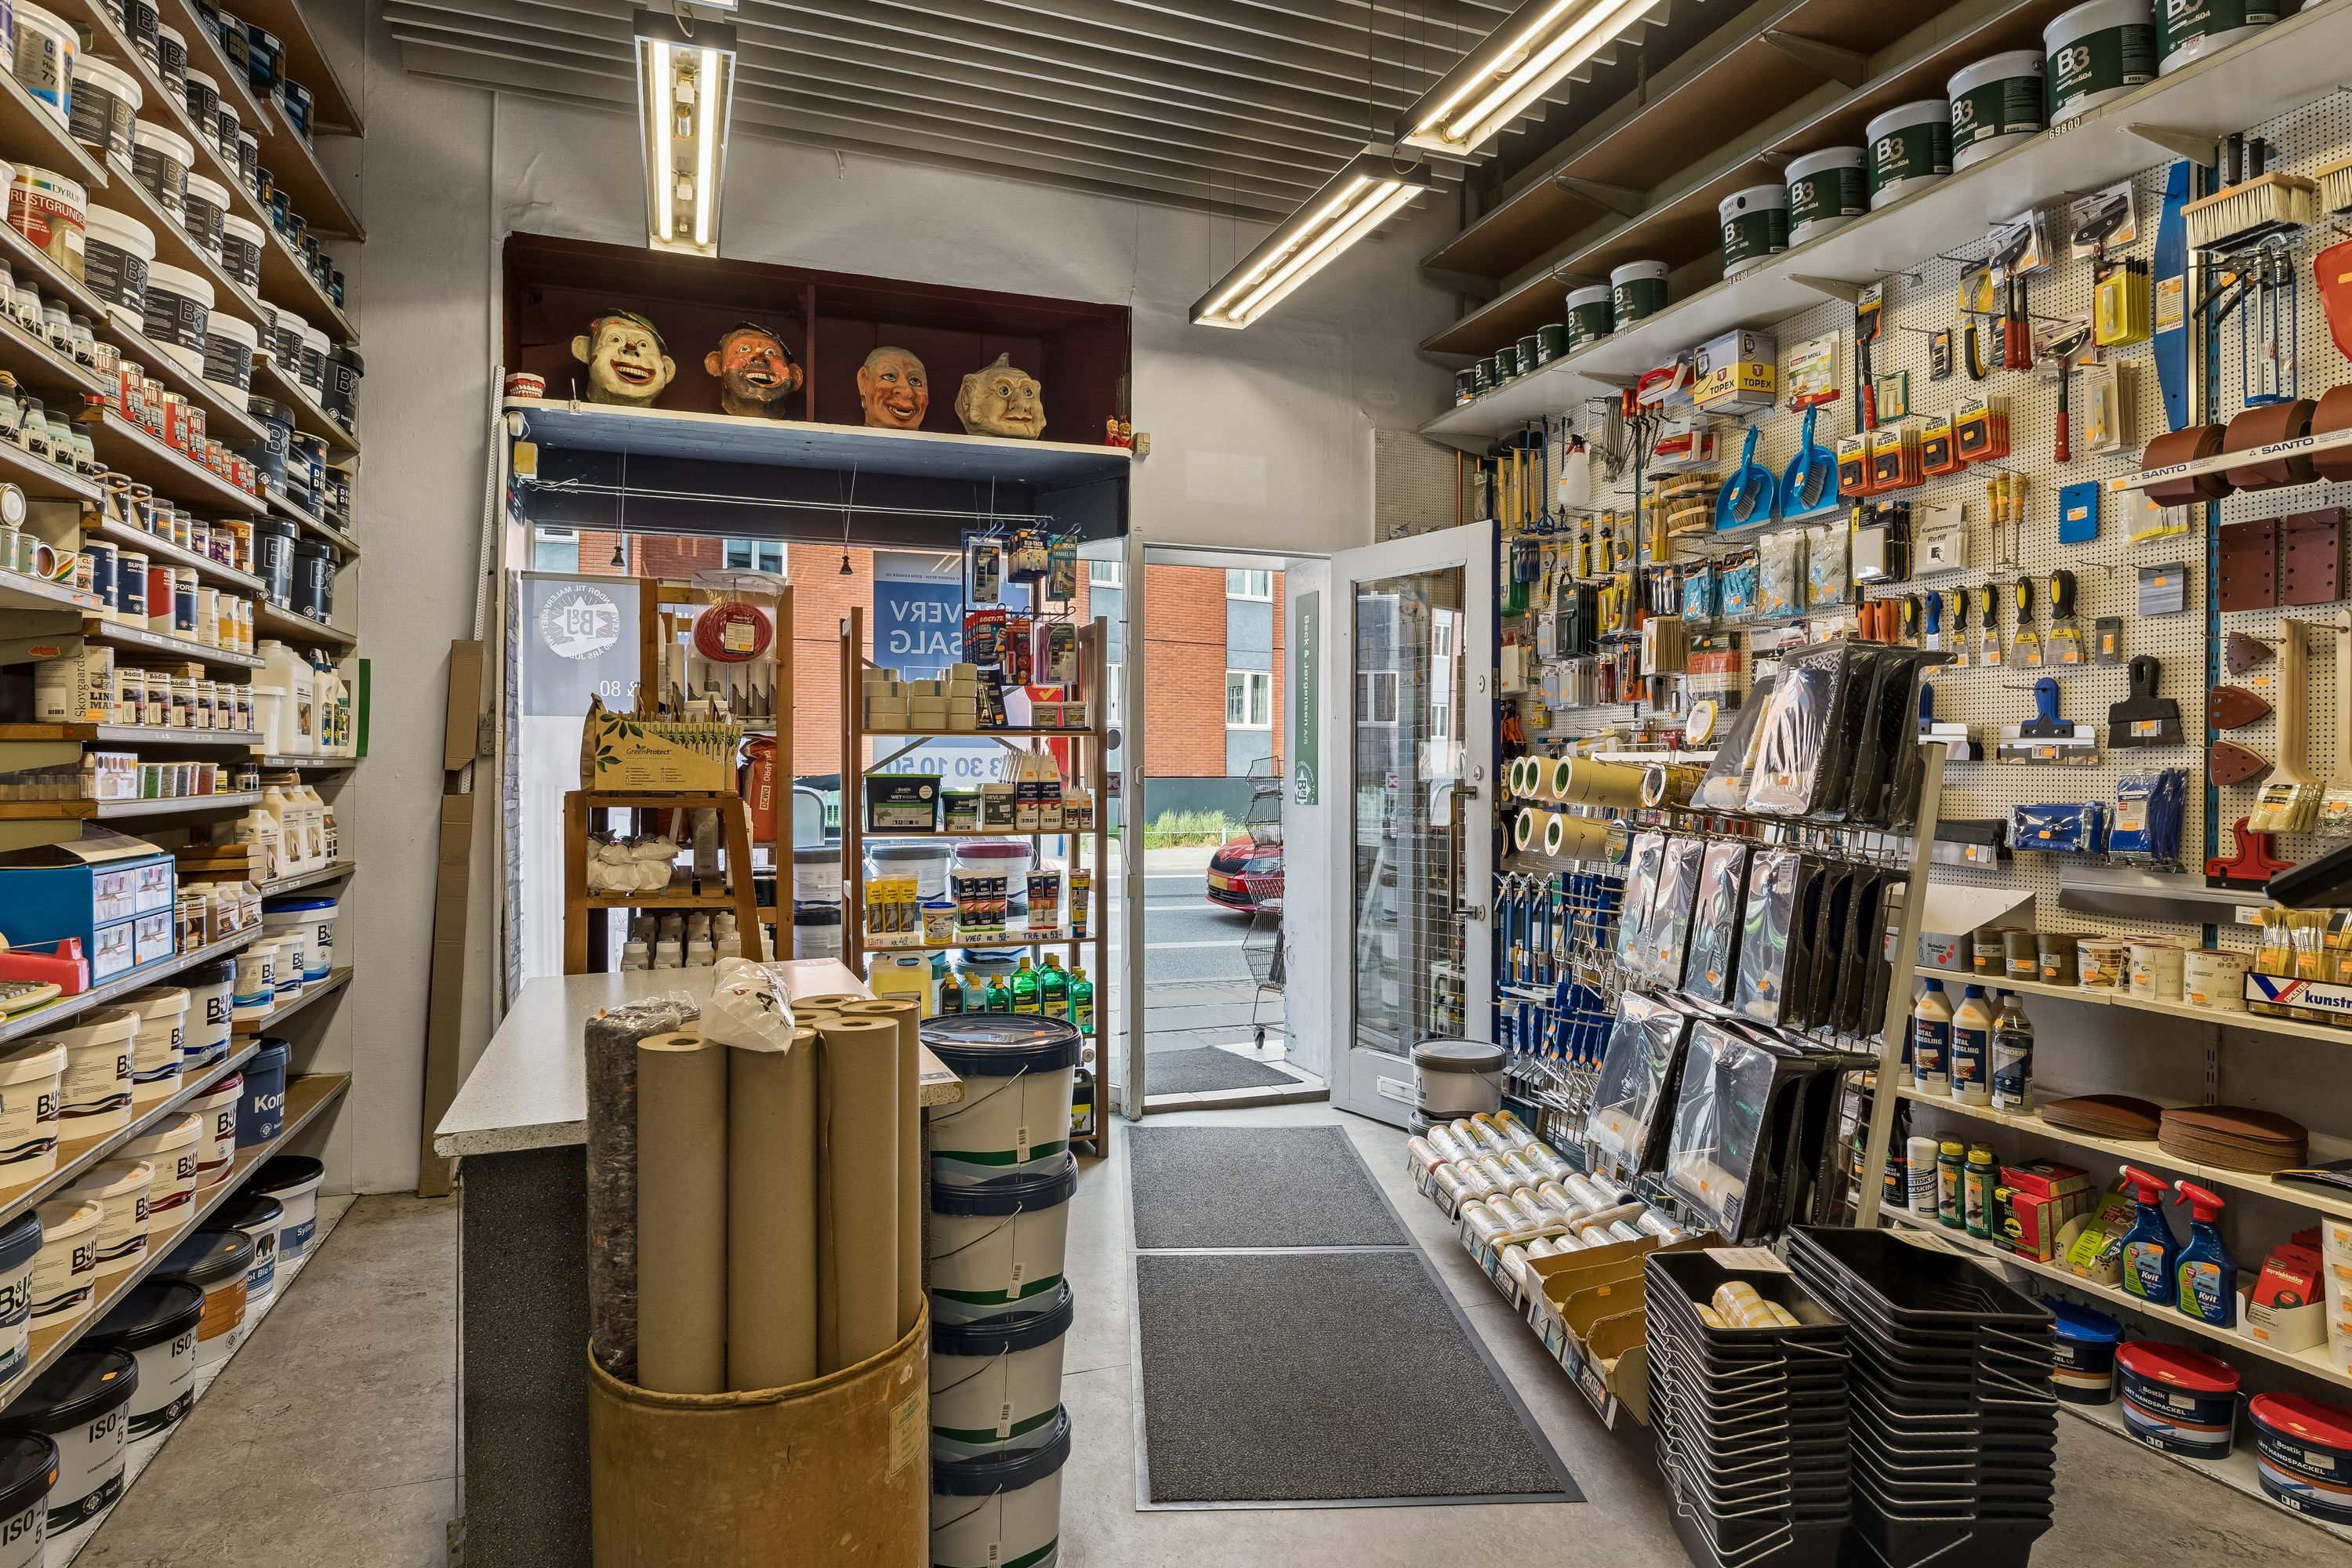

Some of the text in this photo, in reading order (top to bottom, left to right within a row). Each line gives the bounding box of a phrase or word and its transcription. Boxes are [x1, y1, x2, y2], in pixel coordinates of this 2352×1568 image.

[2168, 6, 2199, 26] TRANSPARENT
[2194, 10, 2211, 22] 504
[2057, 45, 2090, 77] B3
[2078, 71, 2092, 82] 504
[1951, 99, 1973, 125] B3
[2048, 117, 2082, 140] 69800
[1877, 137, 1904, 163] B3
[1897, 158, 1909, 167] 504
[163, 157, 188, 197] B3
[1791, 181, 1814, 205] B3
[10, 190, 86, 226] RUSTGRUNDE
[1808, 201, 1819, 209] 504
[124, 255, 147, 295] B3
[1727, 270, 1748, 285] 98900
[179, 298, 205, 334] B3
[1807, 350, 1822, 360] MOLL
[1710, 379, 1735, 394] TOPEX
[1743, 377, 1772, 389] TOPEX
[1960, 403, 1984, 416] BLADES
[1961, 399, 1983, 410] SCRAPER
[1925, 421, 1947, 432] BLADES
[1926, 417, 1947, 427] SCRAPER
[1841, 445, 1862, 455] BLADES
[1876, 437, 1898, 446] BLADES
[2261, 437, 2314, 455] SANTO
[2141, 463, 2187, 480] SANTO
[1922, 522, 1959, 534] Kanttrimmer
[1927, 534, 1947, 543] Refill
[310, 561, 335, 598] B3
[1304, 649, 1310, 659] &
[626, 747, 671, 756] GreenProtect
[760, 786, 770, 809] DM20
[2283, 981, 2310, 1004] SPEKTER
[37, 1090, 60, 1118] B&J
[177, 1152, 197, 1174] B&J
[72, 1239, 97, 1269] B&J
[2141, 1270, 2158, 1283] Kvit
[2198, 1291, 2217, 1304] Kvit
[171, 1330, 197, 1359] ISO-
[1581, 1364, 1600, 1396] SPEKTER
[2142, 1385, 2165, 1399] Bostik
[2135, 1392, 2187, 1416] HANDSPACKEL
[2276, 1439, 2301, 1457] Bostik
[2268, 1446, 2325, 1475] HANDSPACKEL
